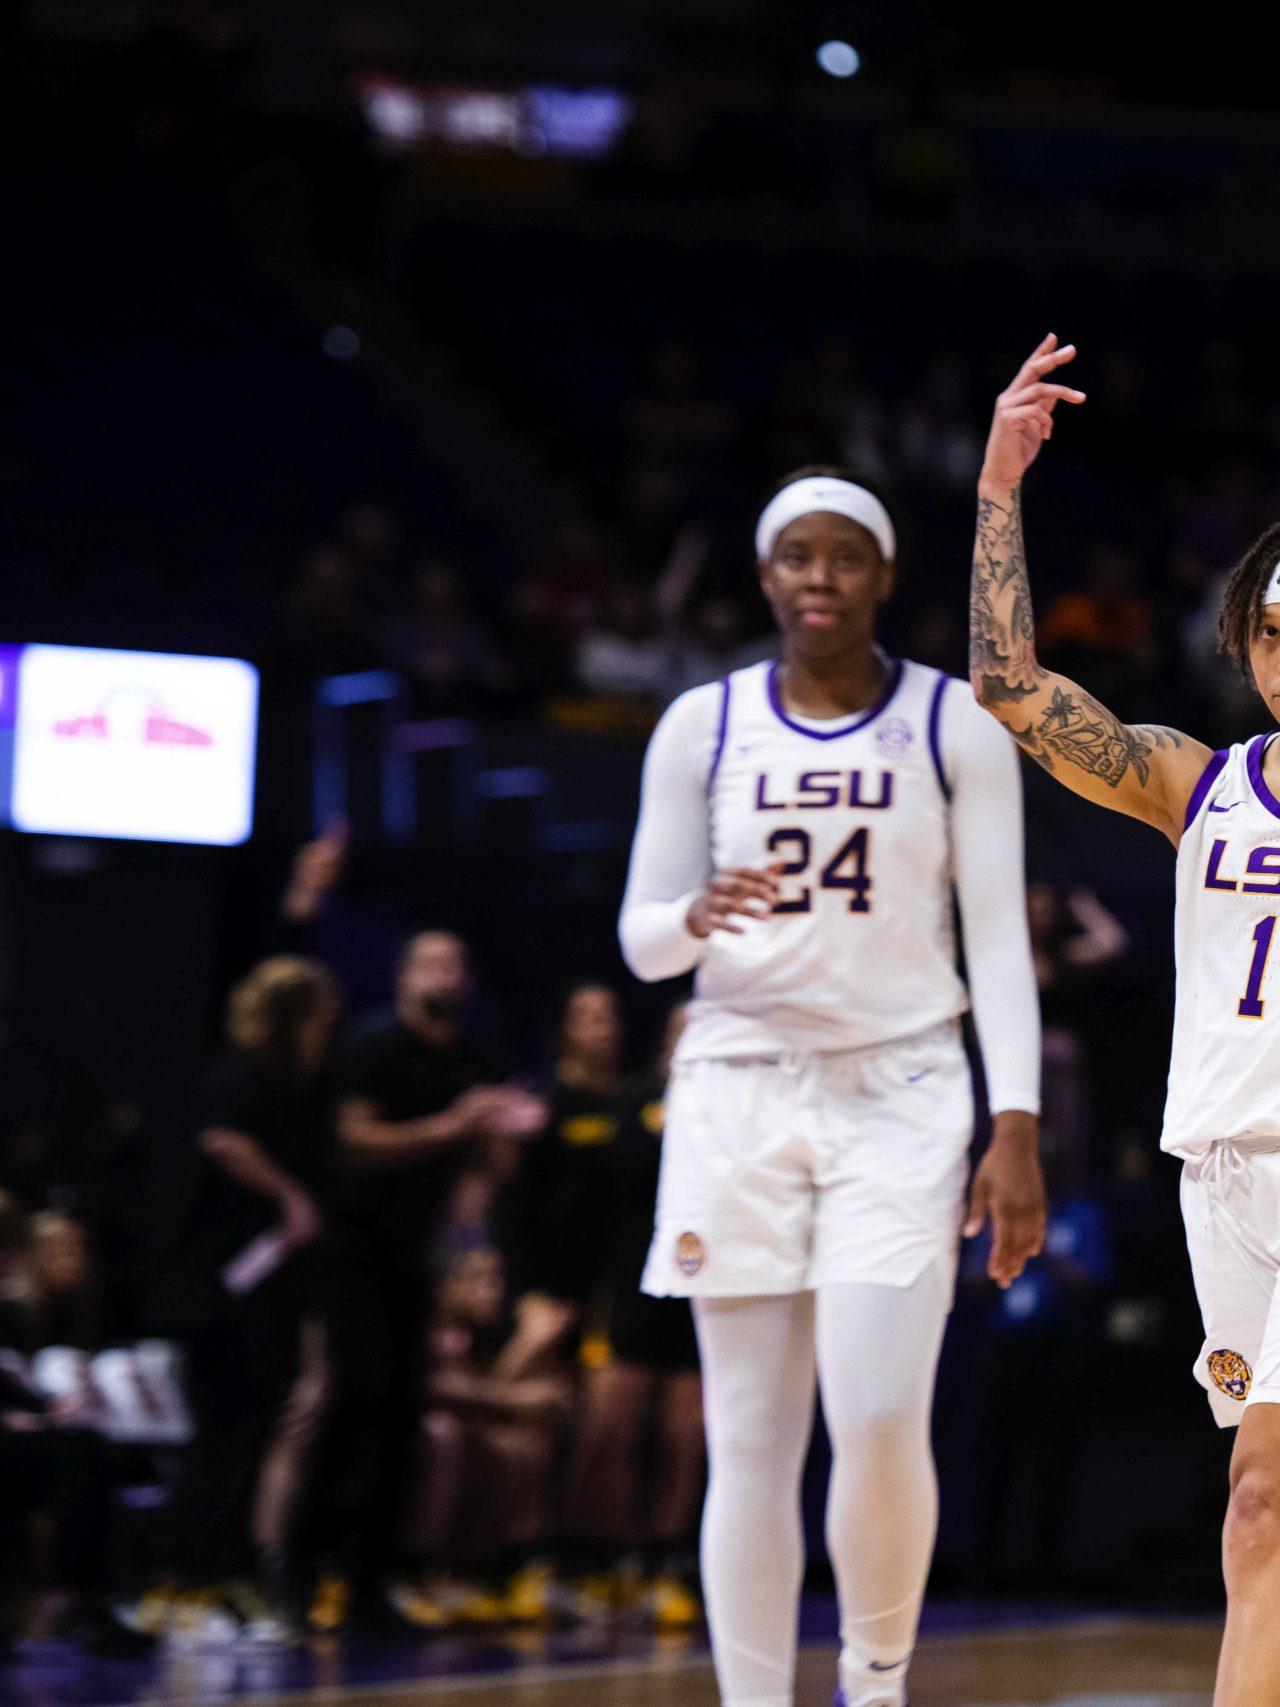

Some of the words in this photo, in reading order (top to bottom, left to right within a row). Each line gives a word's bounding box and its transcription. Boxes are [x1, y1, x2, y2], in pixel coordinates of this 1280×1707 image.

[754, 769, 893, 811] LSU
[766, 826, 871, 915] 24
[1236, 914, 1278, 1019] 1
